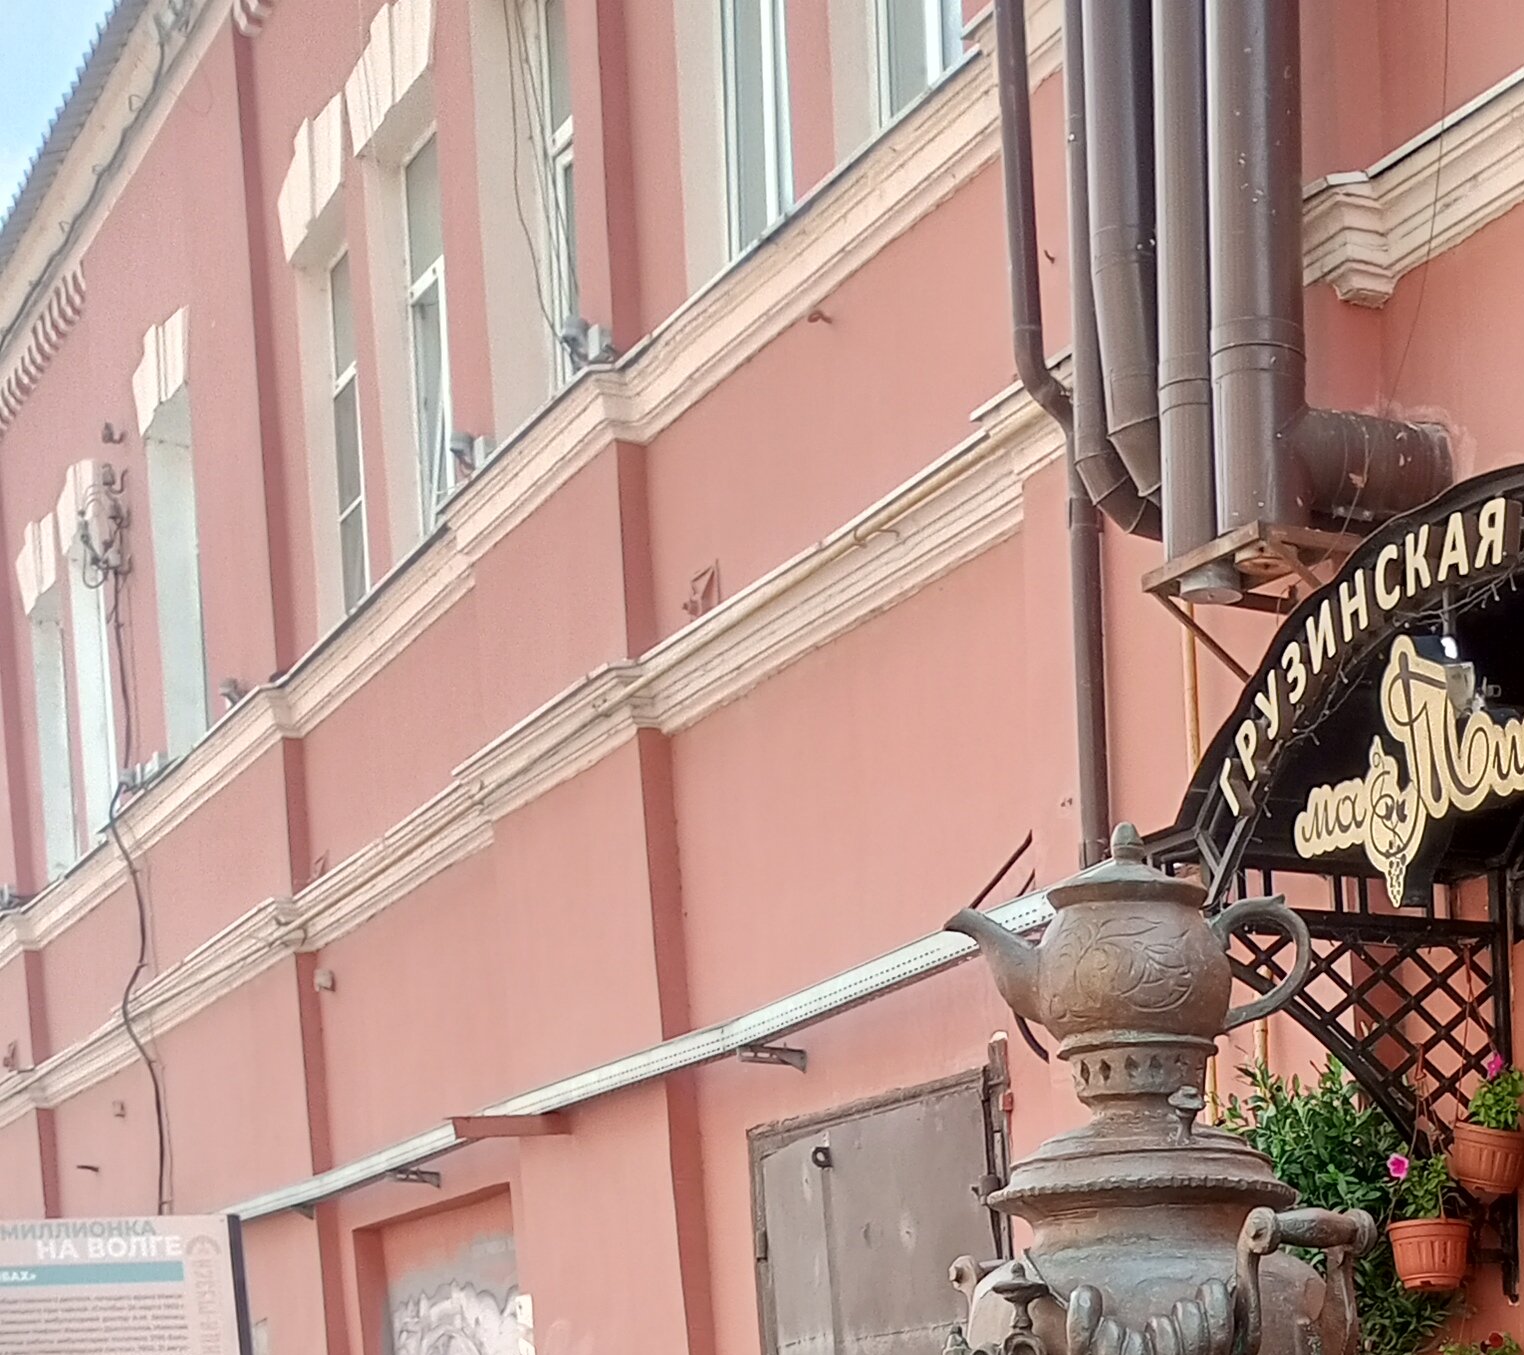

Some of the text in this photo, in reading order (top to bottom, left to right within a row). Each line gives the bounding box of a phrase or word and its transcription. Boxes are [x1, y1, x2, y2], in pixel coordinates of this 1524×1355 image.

[1219, 496, 1509, 818] ГРУЗИНСКАЯ
[36, 1235, 183, 1260] НА ВОЛГЕ
